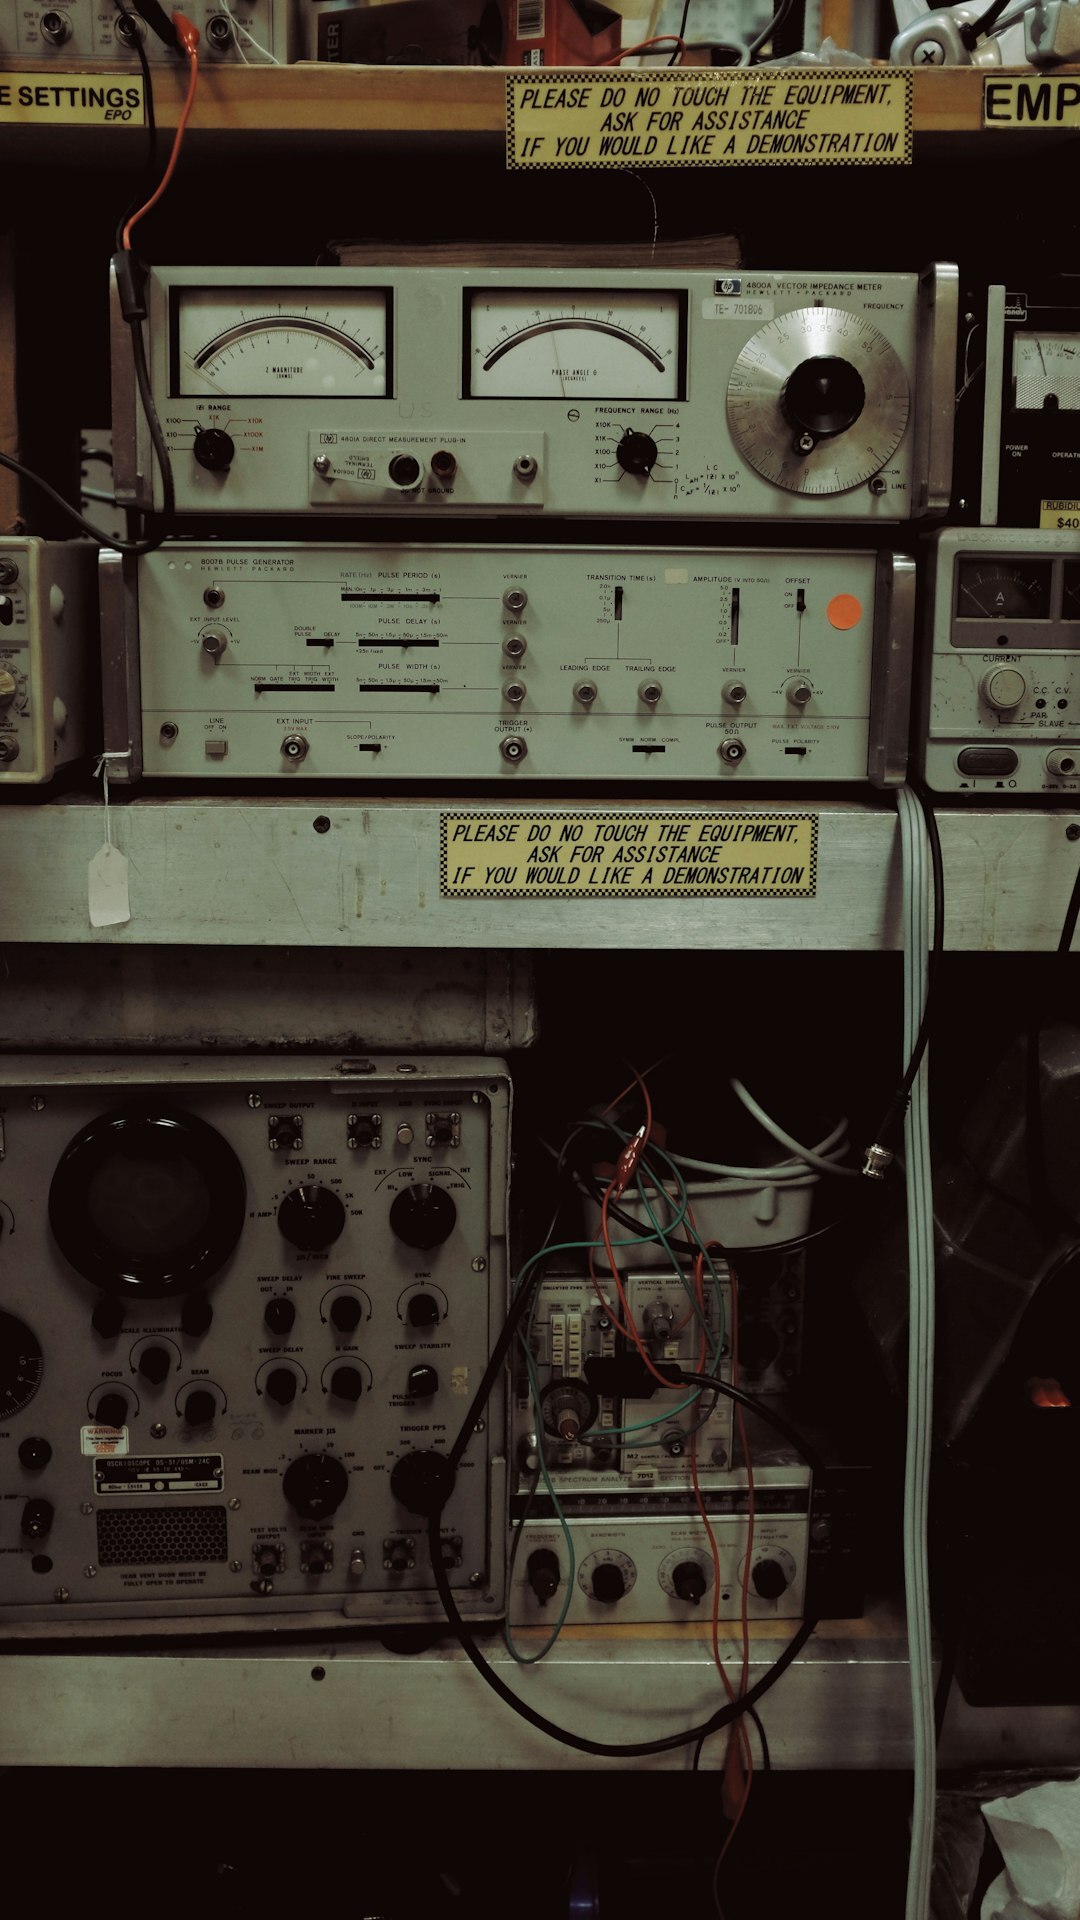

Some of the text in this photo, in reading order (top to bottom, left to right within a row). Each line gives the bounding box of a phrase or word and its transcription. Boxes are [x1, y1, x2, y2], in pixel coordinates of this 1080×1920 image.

[18, 86, 140, 108] SETTINGS
[520, 84, 891, 109] PLEASE DO NO TOUCH THE EQUIPMENT,
[986, 83, 1080, 121] EMP
[104, 110, 132, 121] EPO
[600, 109, 811, 132] ASK FOR ASSISTANCE
[520, 132, 899, 157] IF YOU WOULD LIKE A DEMONSTRATION
[776, 282, 807, 290] VECTOR
[272, 366, 303, 374] MAGNITUDE
[345, 460, 373, 468] TERMINAL
[1057, 517, 1080, 528] $40
[982, 654, 1022, 662] CURRENT
[452, 824, 798, 843] PLEASE DO NO TOUCH THE EQUIPMENT,
[527, 845, 723, 863] ASK FOR ASSISTANCE
[452, 866, 805, 884] IF YOU WOULD LIKE A DEMONSTRATION
[294, 1427, 323, 1435] MARKER
[559, 1475, 598, 1483] SPECTRUM
